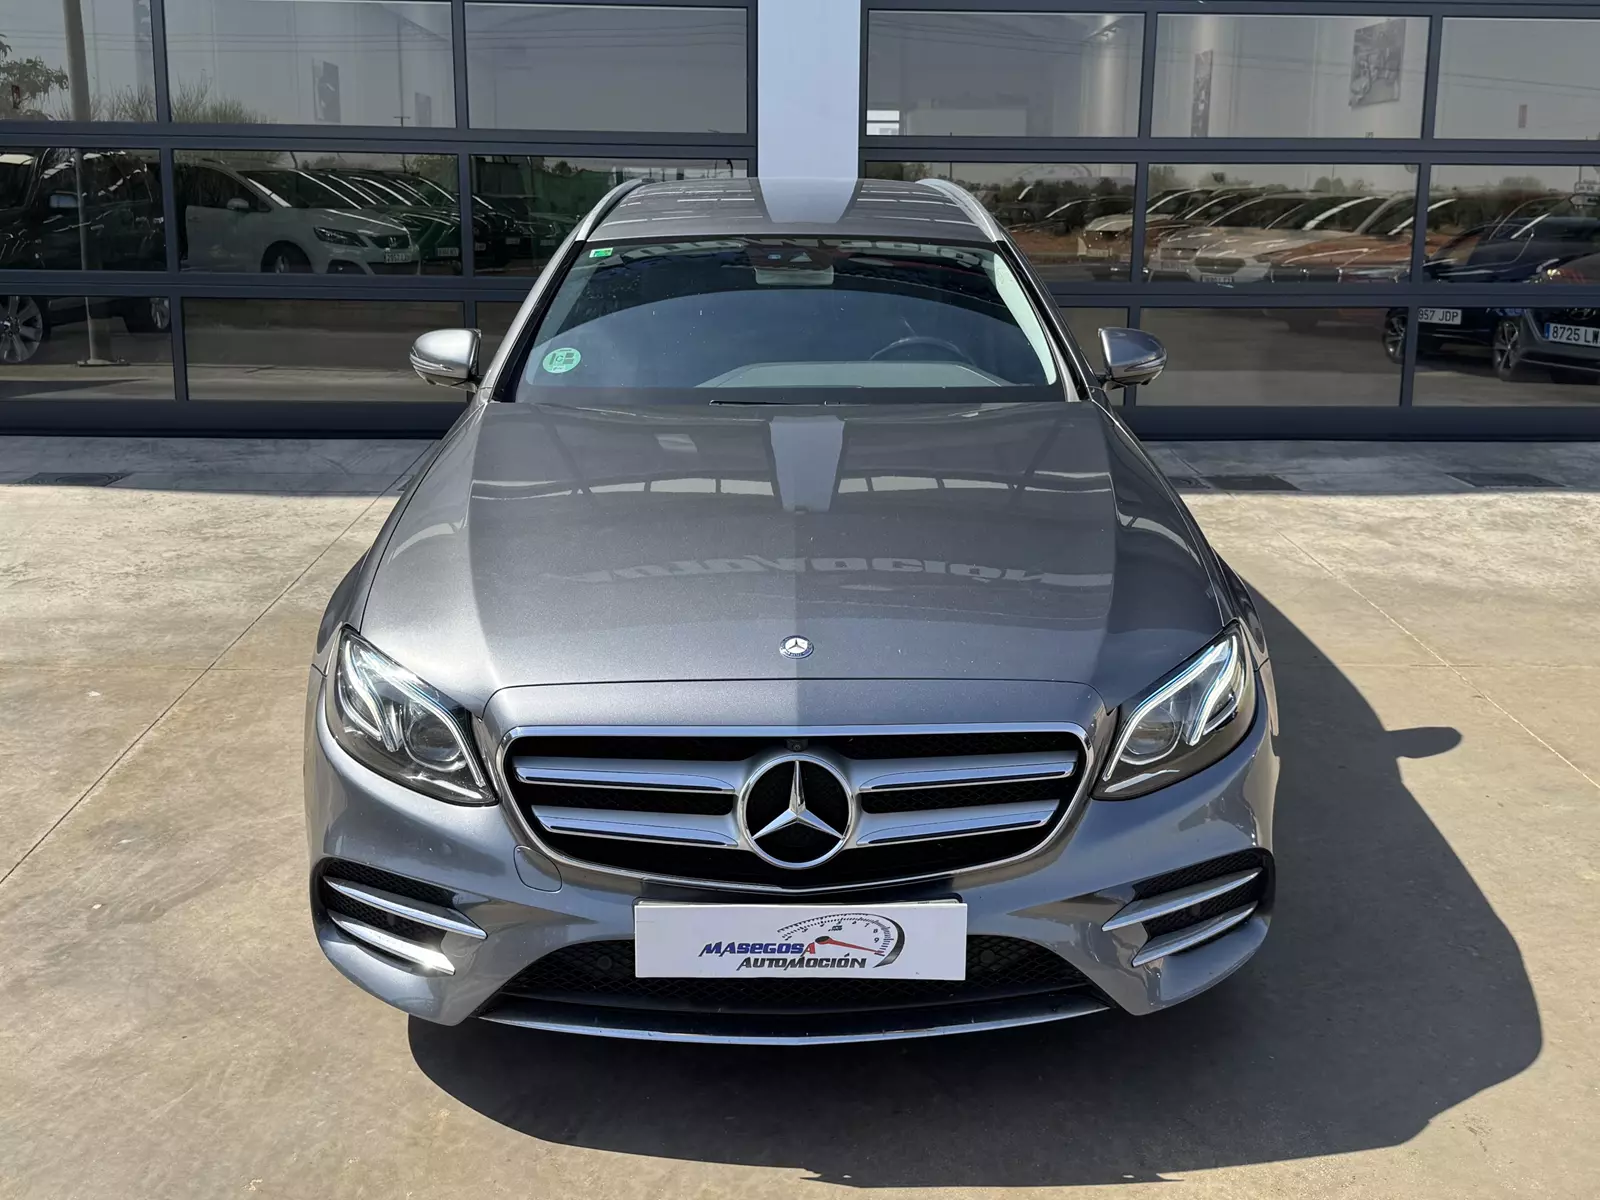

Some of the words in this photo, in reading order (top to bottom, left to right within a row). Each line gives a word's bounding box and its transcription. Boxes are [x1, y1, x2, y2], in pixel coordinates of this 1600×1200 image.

[1439, 310, 1459, 322] JDP
[1552, 325, 1580, 342] 8725
[1584, 328, 1600, 345] LW
[698, 942, 816, 957] MASEGOSA
[736, 953, 867, 971] AUTOMOCIÓN
